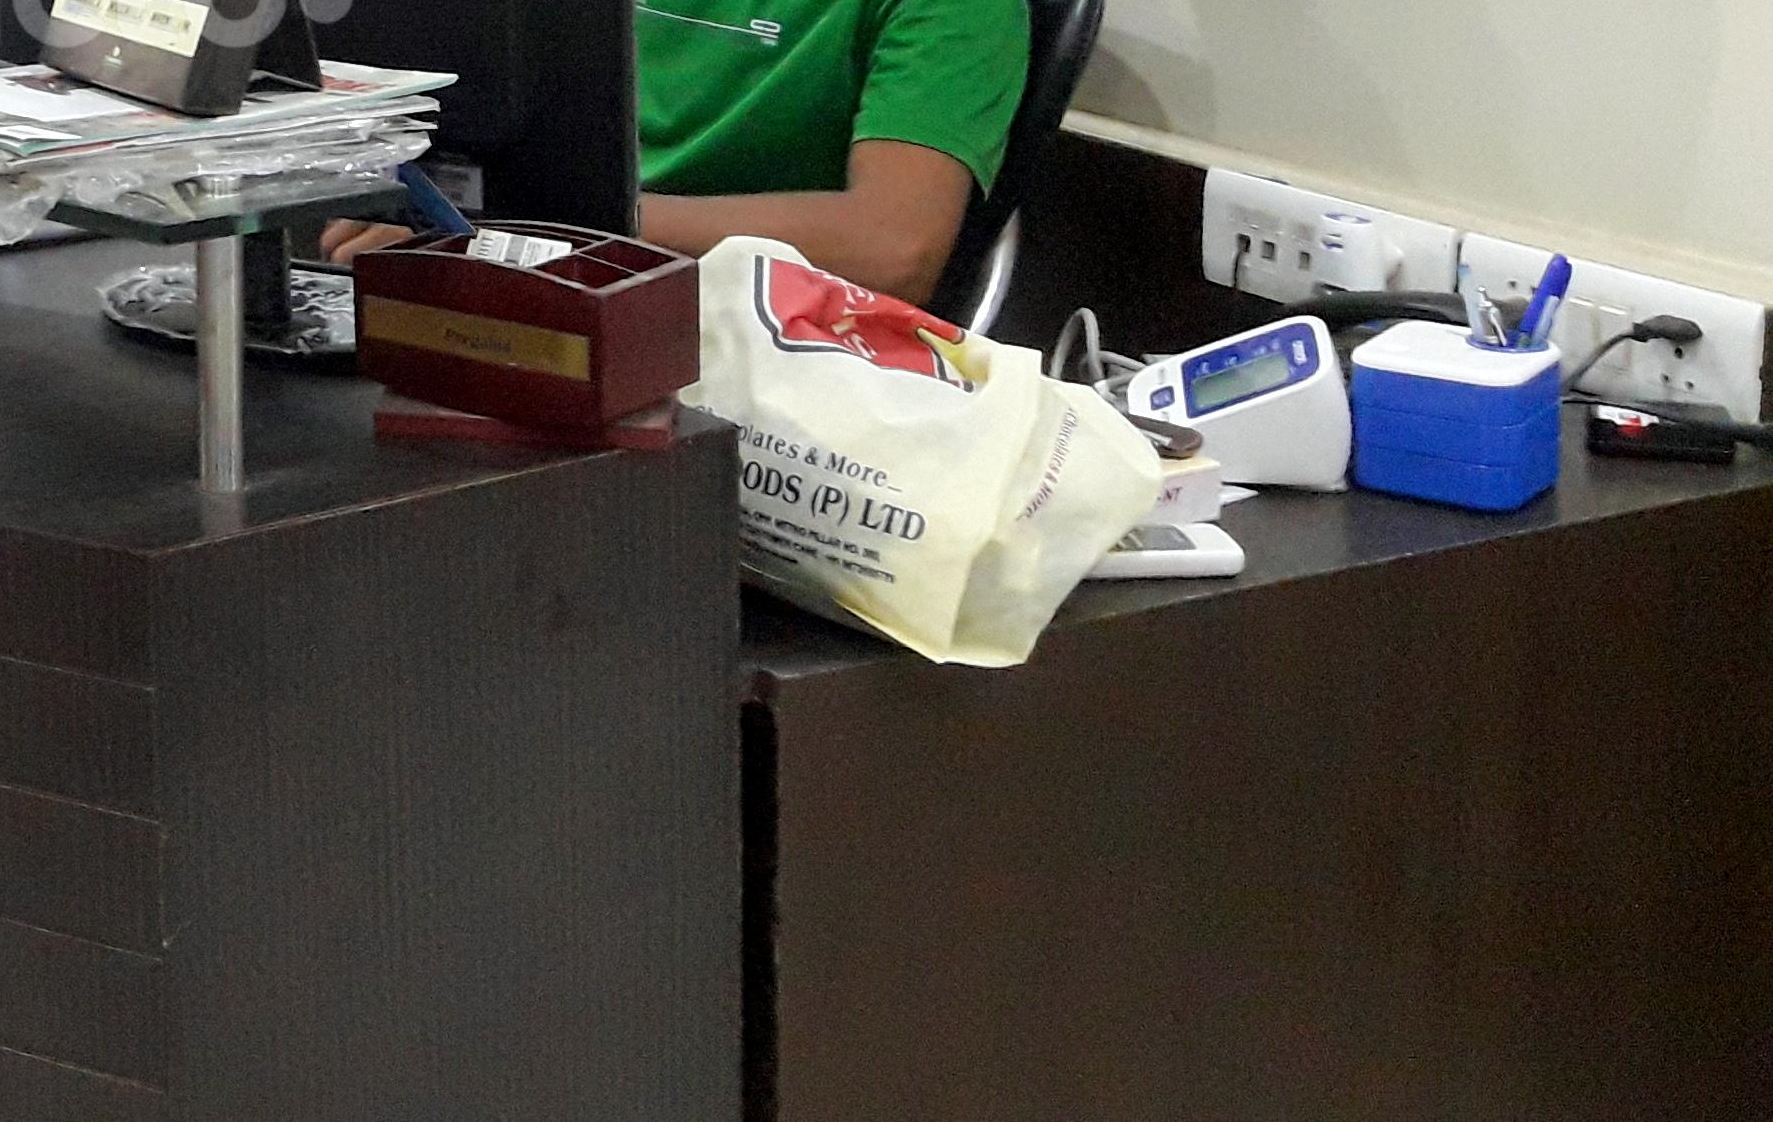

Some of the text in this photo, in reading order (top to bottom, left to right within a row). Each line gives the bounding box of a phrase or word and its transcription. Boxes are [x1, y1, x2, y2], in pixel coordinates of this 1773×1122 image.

[737, 424, 801, 460] olates
[804, 446, 818, 466] &
[742, 460, 926, 542] ODS (P) LTD
